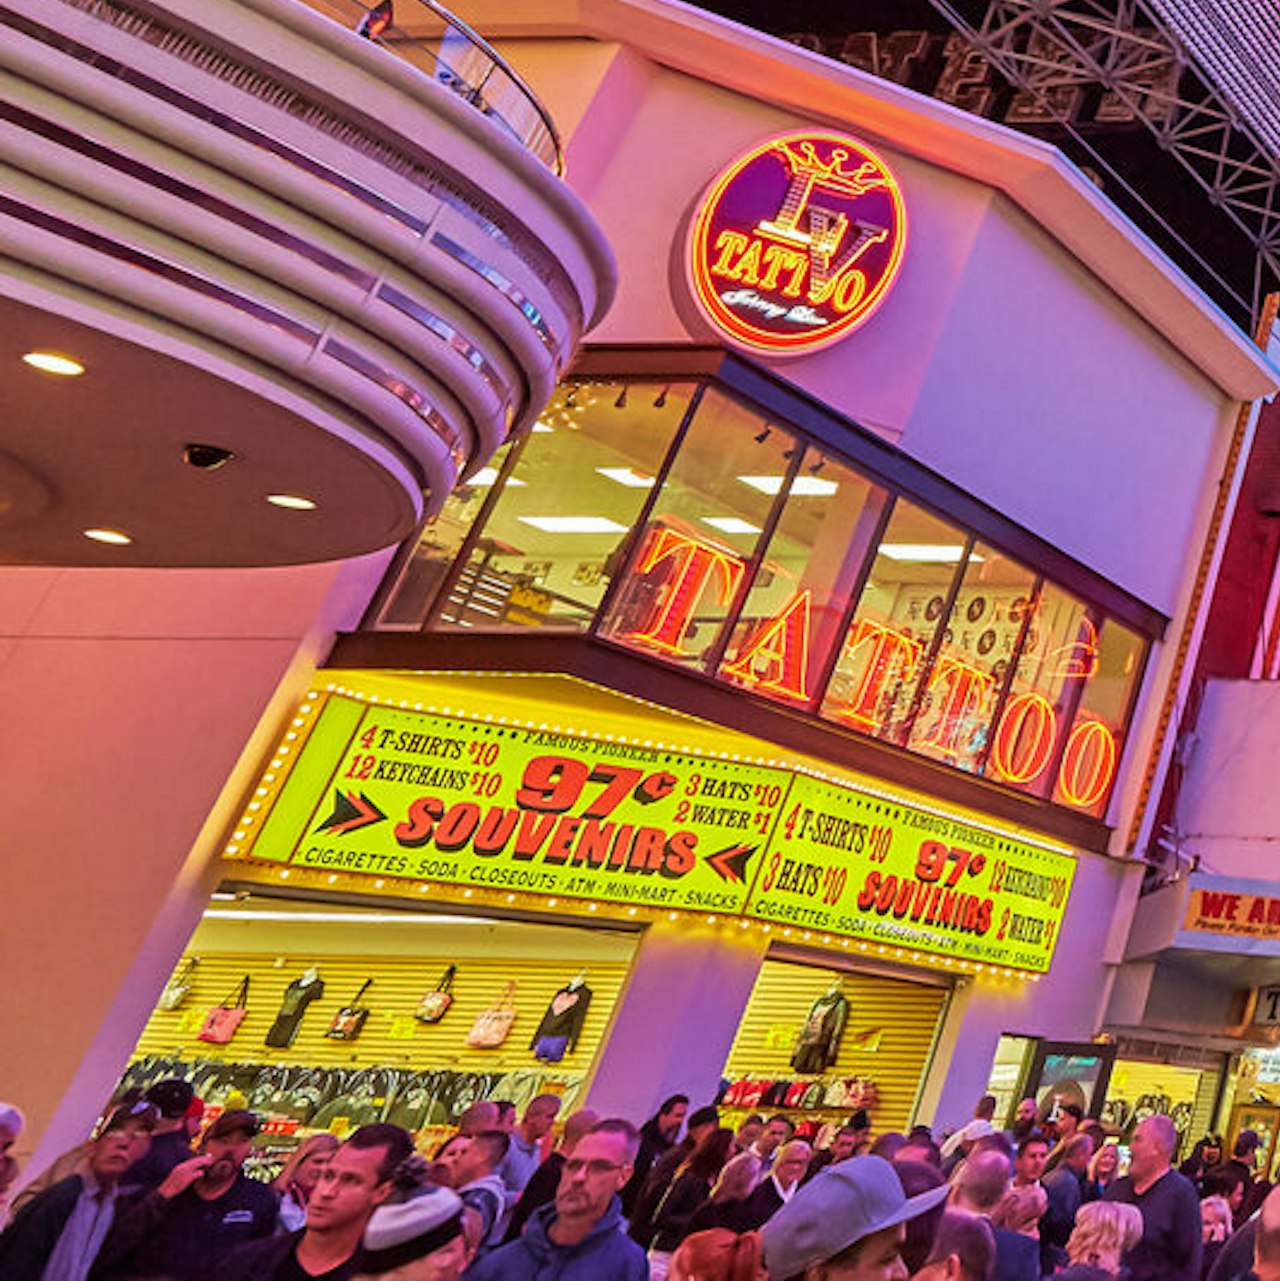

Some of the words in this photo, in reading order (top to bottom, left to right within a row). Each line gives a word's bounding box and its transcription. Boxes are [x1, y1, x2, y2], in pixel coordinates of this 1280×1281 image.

[634, 528, 1117, 807] TATTOO
[359, 724, 376, 749] 4
[377, 729, 463, 760] T-SHIRTS
[468, 741, 500, 768] $10
[524, 731, 588, 754] FAMOUS
[592, 742, 658, 763] PIONEER
[344, 756, 372, 782] 12
[373, 759, 470, 792] KEYCHAINS
[471, 770, 501, 798] $10
[516, 755, 679, 821] 97¢
[684, 773, 700, 797] 3
[701, 777, 753, 802] HATS
[753, 783, 782, 808] $10
[394, 797, 699, 878] SOUVENIRS
[673, 800, 689, 824] 2
[690, 805, 751, 831] WATER
[753, 812, 770, 835] $1
[784, 802, 802, 840] 4
[797, 808, 869, 854] T-SHIRTS
[869, 824, 893, 864] $10
[304, 846, 407, 875] CIGARETTES
[416, 859, 459, 879] SODA
[470, 865, 556, 891] CLOSEOUTS
[565, 877, 596, 896] ATM
[605, 881, 678, 904] MINI-MART
[684, 890, 739, 912] SNACKS
[763, 852, 782, 892] 3
[776, 859, 824, 898] HATS
[823, 866, 848, 907] $10
[755, 899, 832, 927] CIGARETTES
[835, 915, 867, 934] SODA
[857, 871, 994, 937] SOUVENIRS
[1199, 891, 1242, 921] WE
